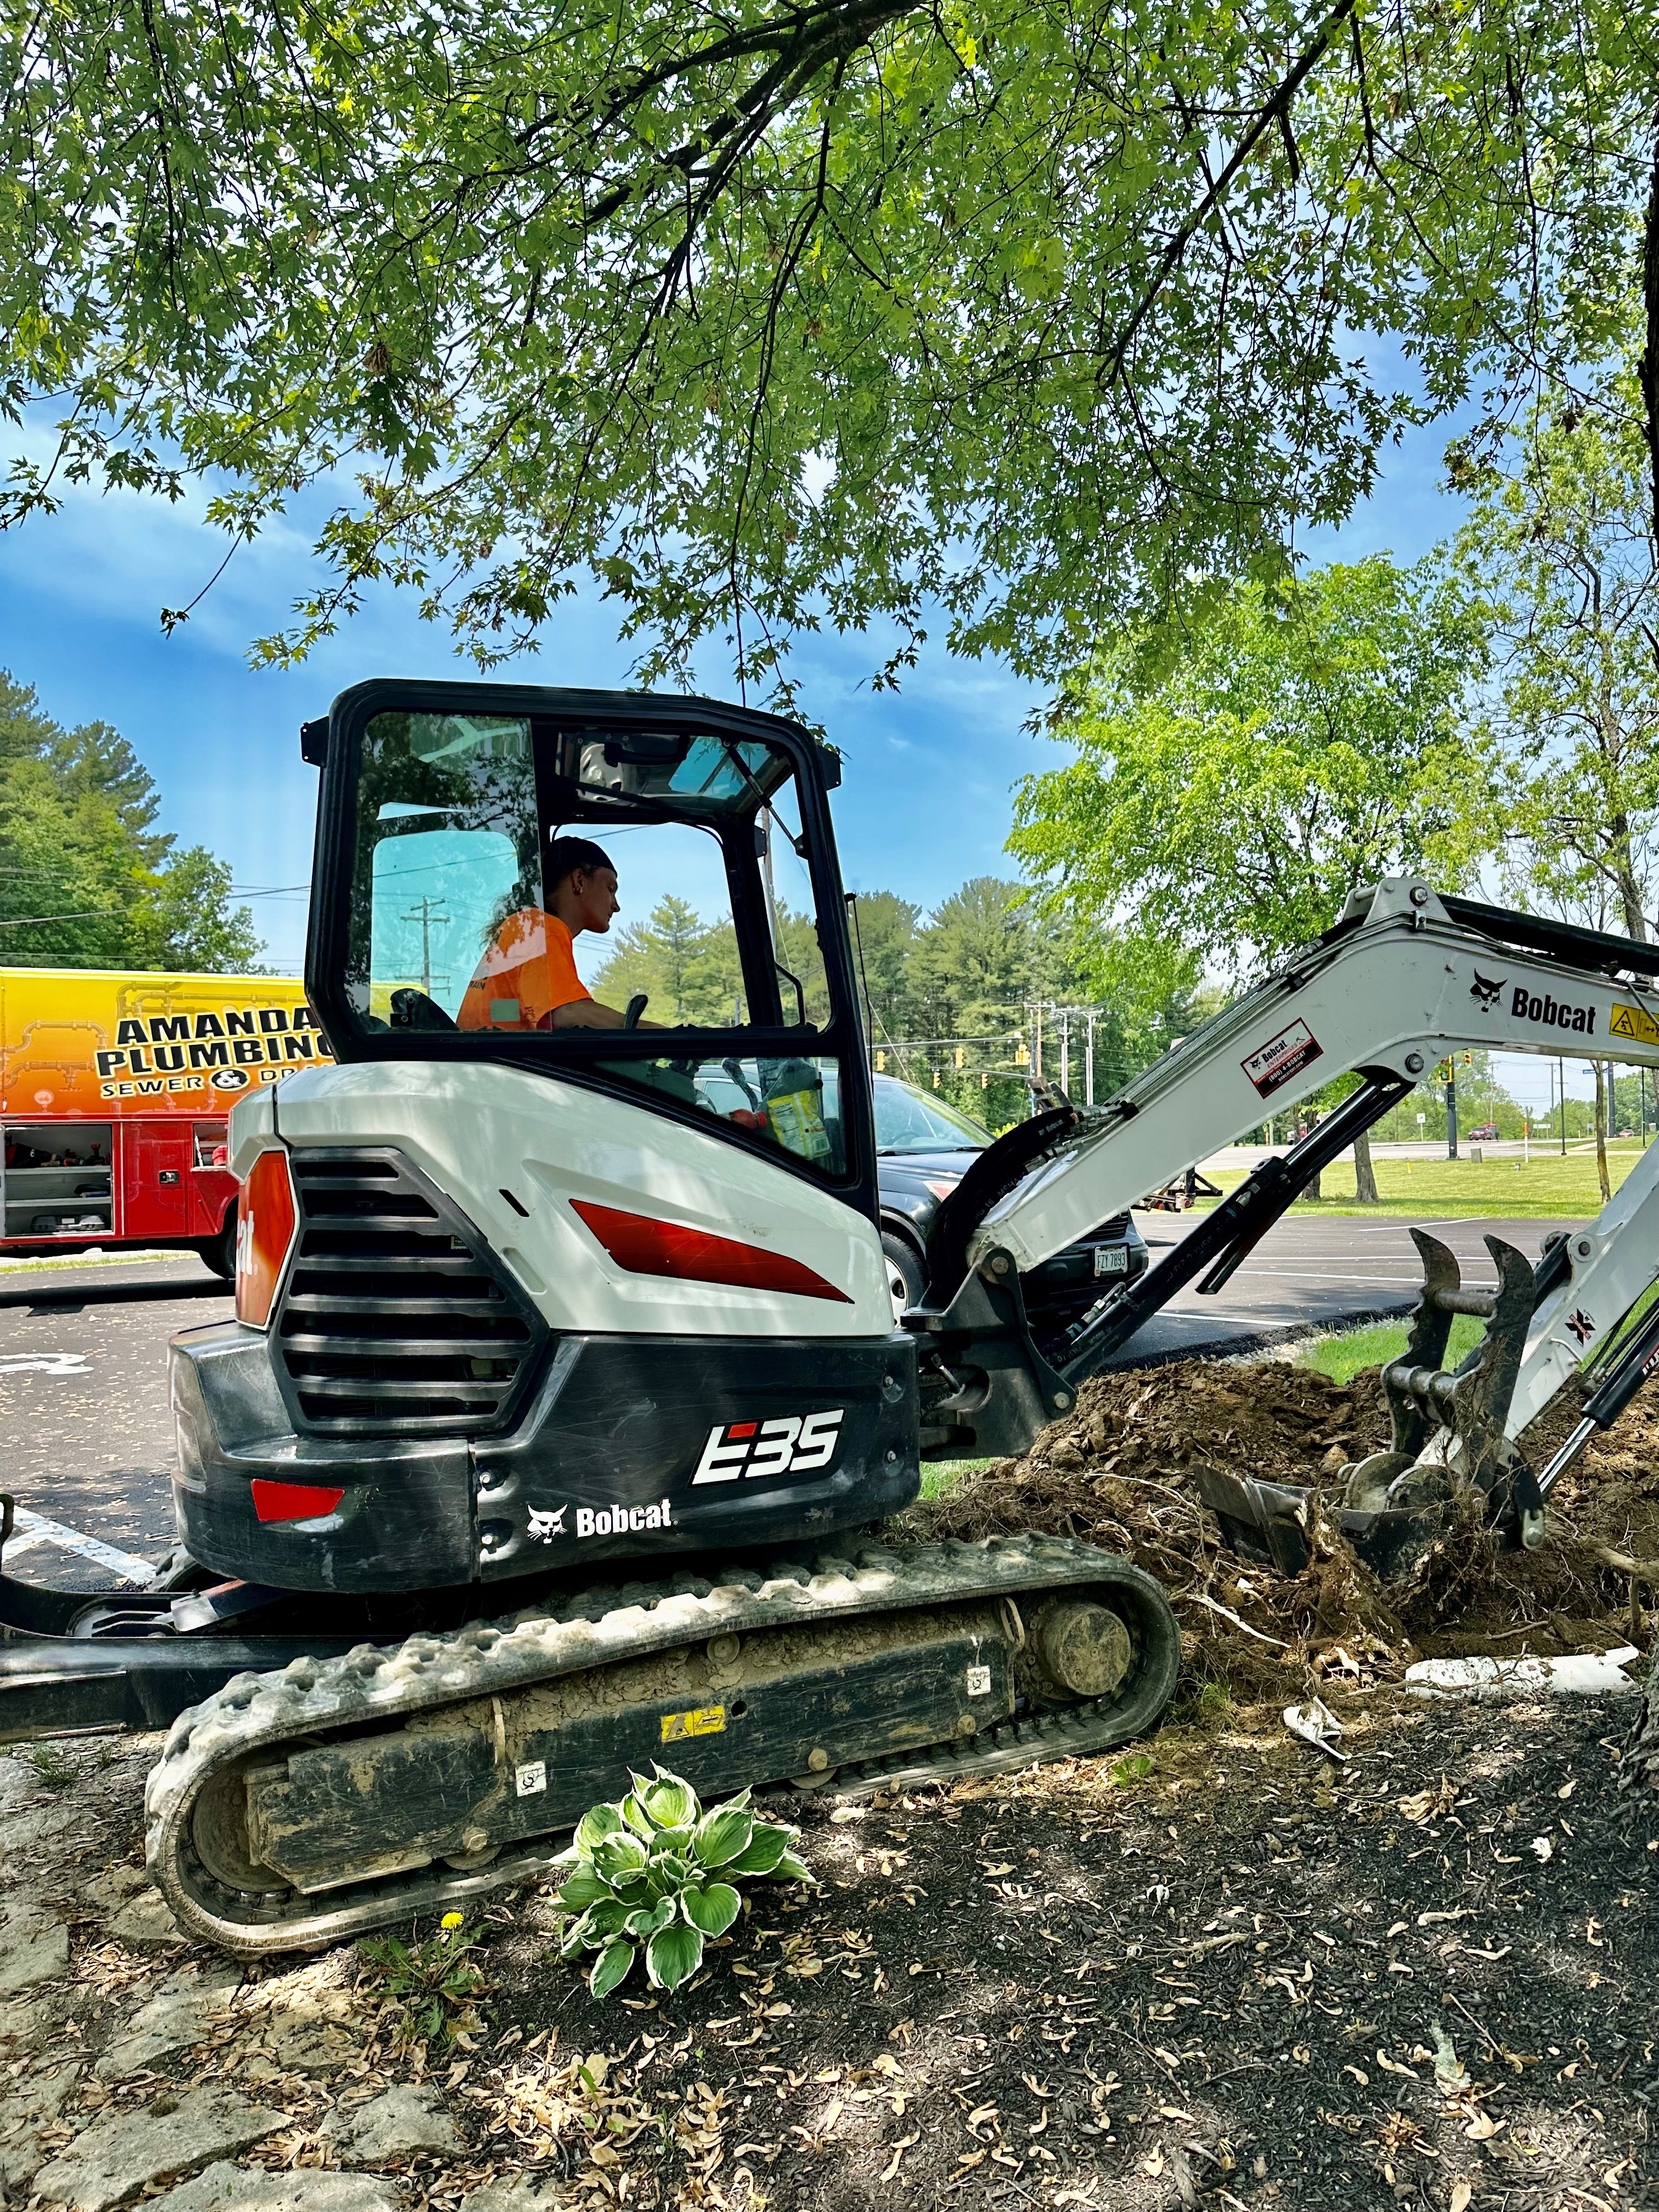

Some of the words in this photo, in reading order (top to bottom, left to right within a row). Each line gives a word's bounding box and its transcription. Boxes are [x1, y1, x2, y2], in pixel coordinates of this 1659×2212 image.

[1511, 987, 1596, 1035] Bobcat
[117, 1007, 320, 1045] AMANDA
[1261, 1040, 1288, 1063] Bobcat
[1267, 1042, 1297, 1068] ENTERPRISES
[102, 1077, 202, 1097] SEWER
[1268, 1069, 1283, 1082] (800)
[1097, 1254, 1108, 1269] FZY
[1110, 1252, 1126, 1267] 7893
[692, 1409, 844, 1485] E35
[576, 1498, 672, 1537] Bobcat
